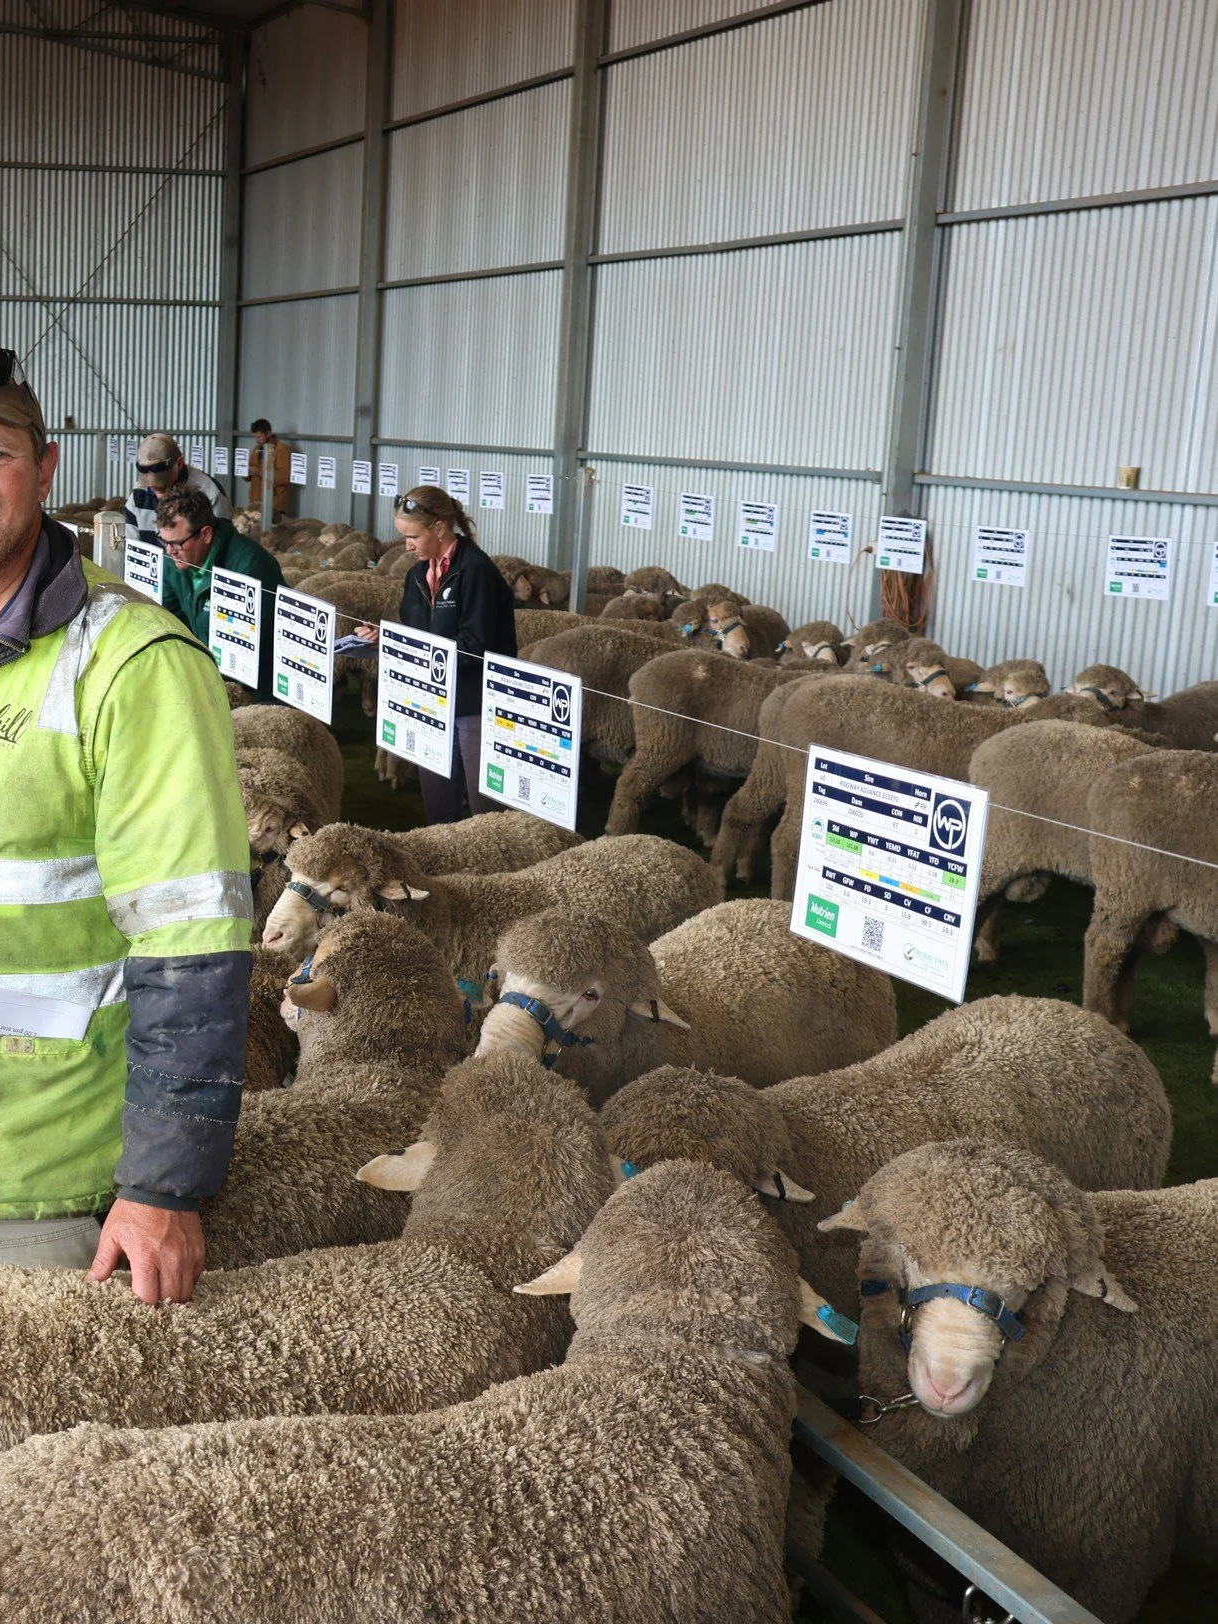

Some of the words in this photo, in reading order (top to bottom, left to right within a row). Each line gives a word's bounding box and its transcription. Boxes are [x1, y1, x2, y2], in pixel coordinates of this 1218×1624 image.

[820, 761, 828, 770] Lot
[864, 774, 874, 783] Sire
[914, 788, 928, 798] Horn
[818, 785, 826, 795] Tag
[851, 796, 863, 806] Dam
[891, 808, 903, 818] CON
[849, 830, 858, 838] WP
[867, 836, 879, 845] YWT
[885, 842, 901, 852] YEMD
[907, 849, 920, 859] YFAT
[928, 856, 939, 865] YFD
[947, 862, 964, 873] YCFW
[810, 901, 836, 921] Nutrien
[842, 877, 855, 887] GFW
[864, 884, 872, 893] FD
[883, 891, 892, 900] SD
[903, 898, 912, 907] CV
[924, 906, 932, 914] CF
[943, 913, 956, 923] CRV
